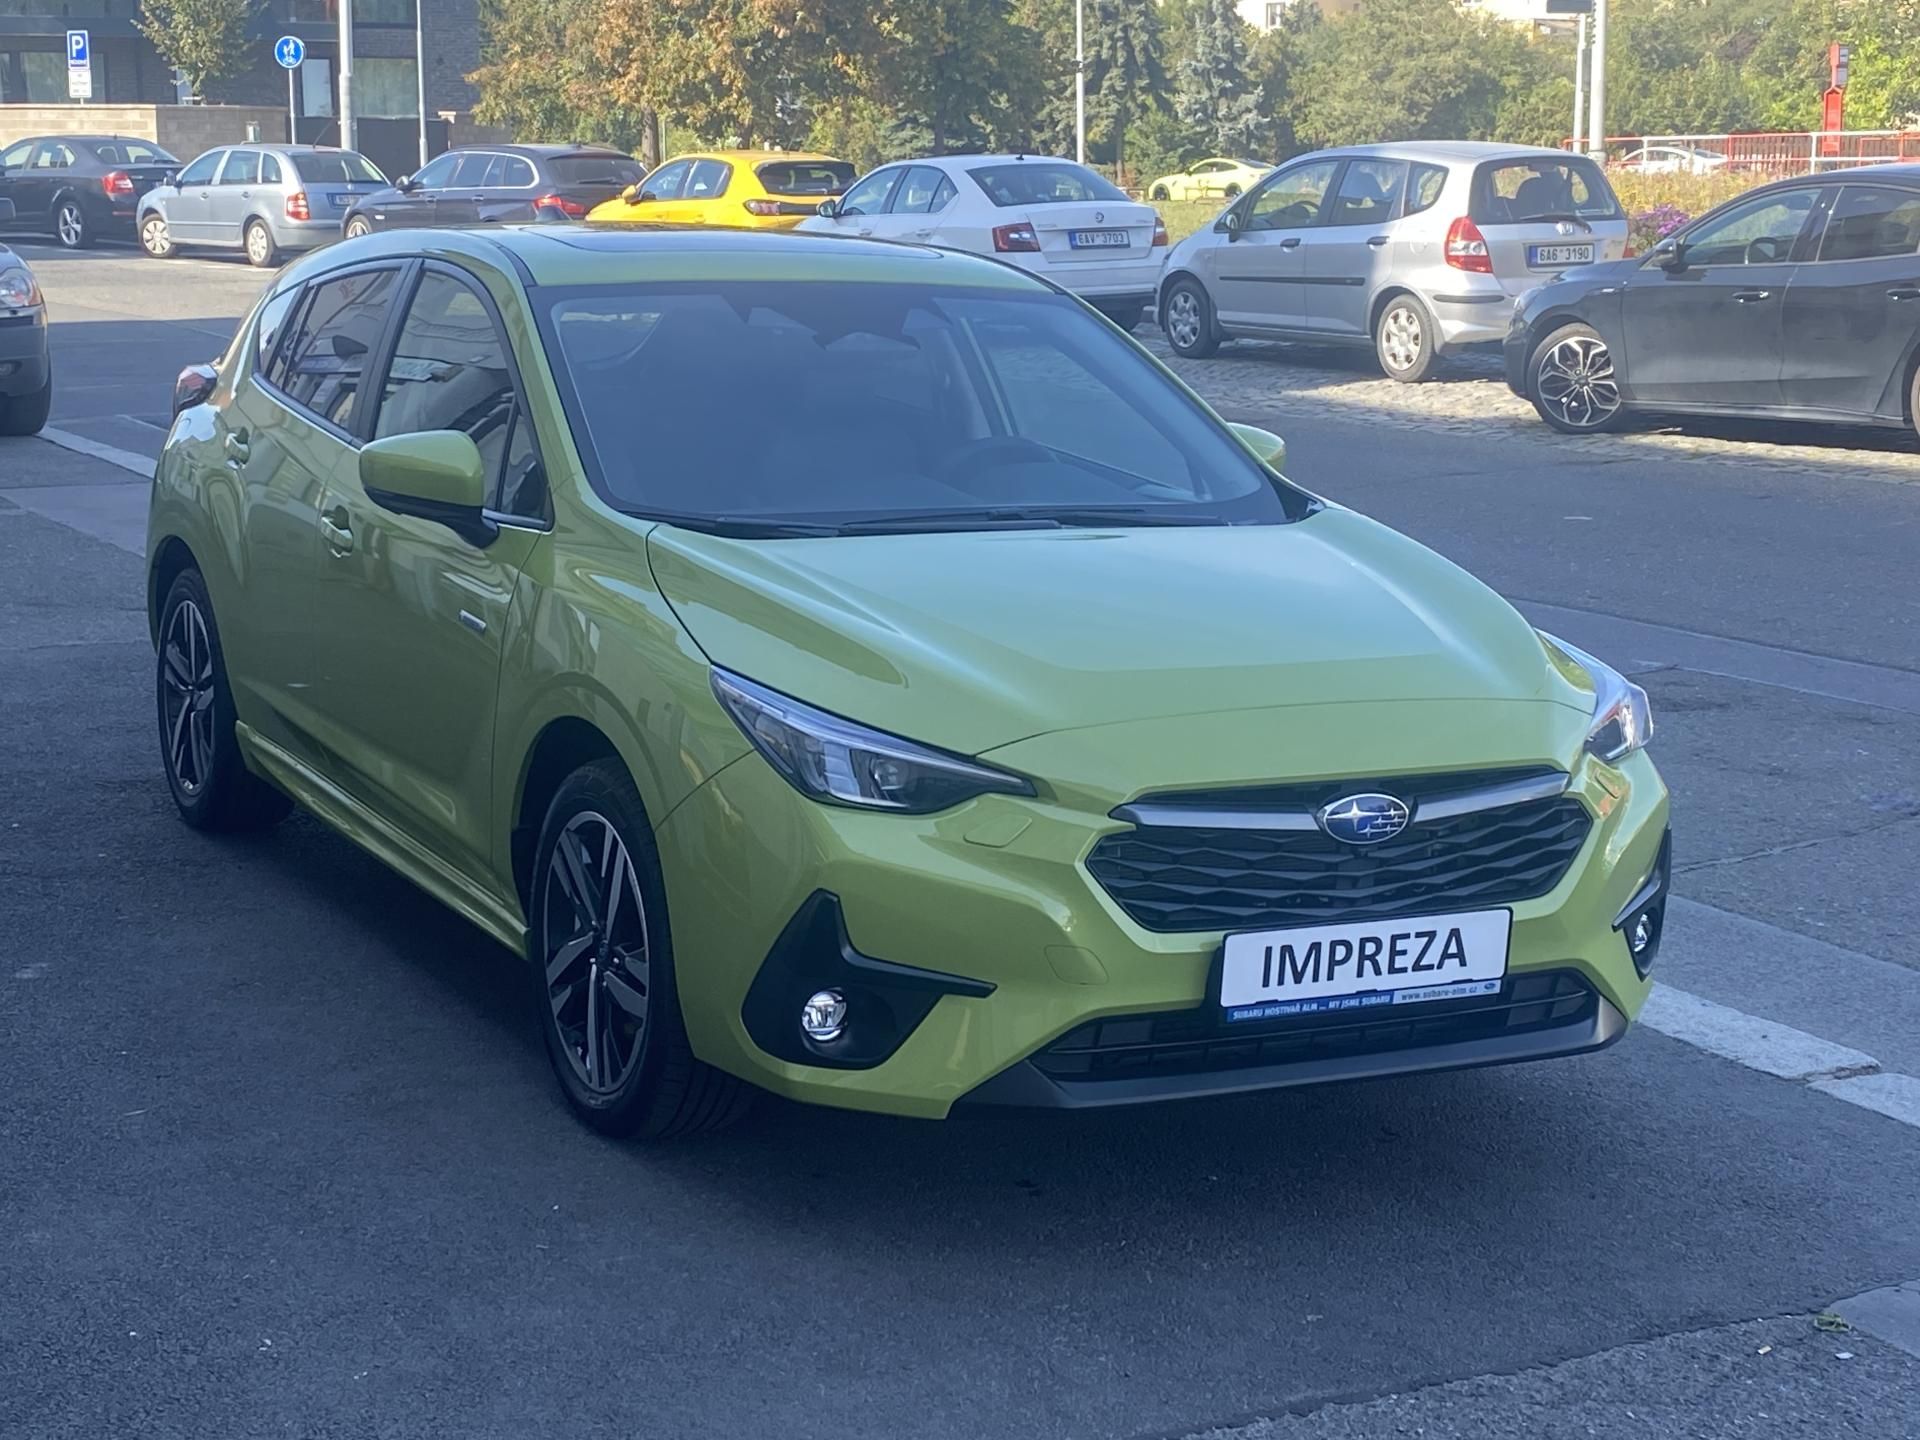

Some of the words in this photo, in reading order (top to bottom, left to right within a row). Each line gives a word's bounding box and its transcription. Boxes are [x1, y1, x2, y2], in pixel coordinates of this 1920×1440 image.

[71, 35, 84, 58] P
[1102, 232, 1124, 243] 3703
[1540, 248, 1558, 261] 6A6
[1565, 247, 1589, 260] 3190
[1262, 927, 1467, 988] IMPREZA
[1232, 1007, 1263, 1020] SUBARU
[1302, 1002, 1318, 1012] ALM
[1328, 1001, 1340, 1009] MY
[1361, 995, 1391, 1006] SUBARU
